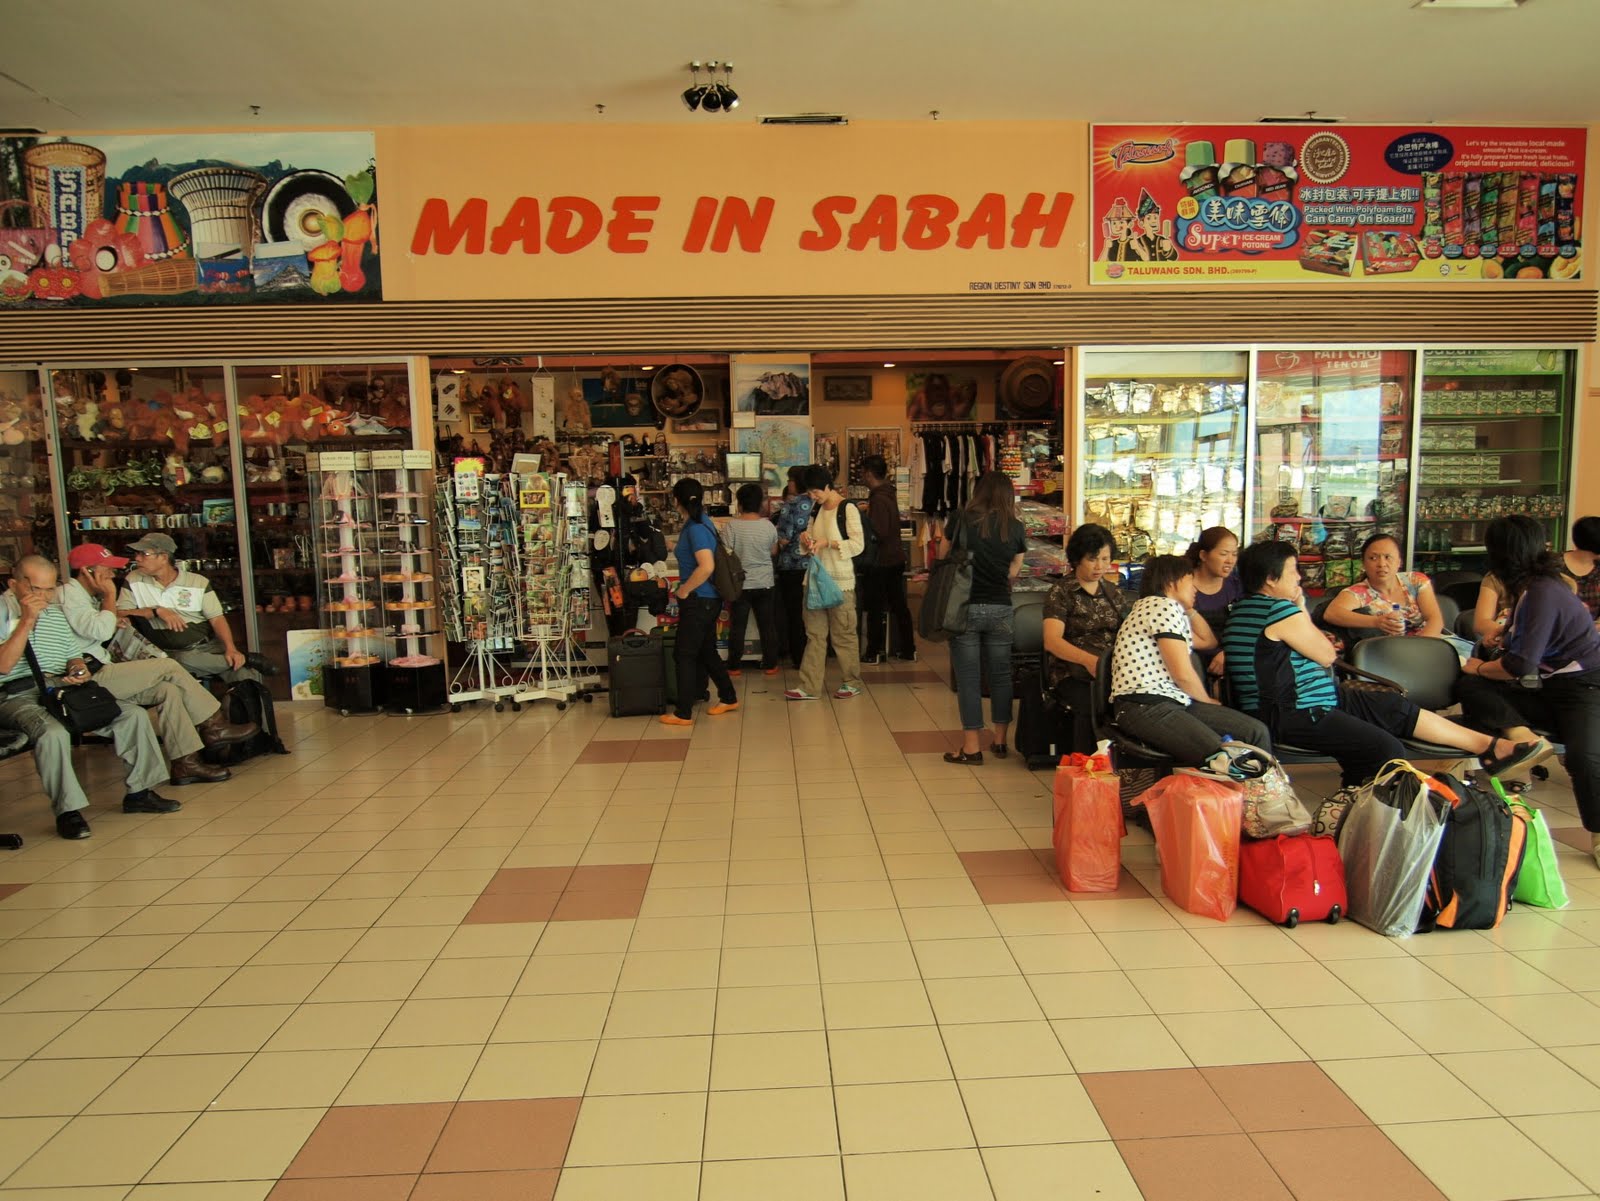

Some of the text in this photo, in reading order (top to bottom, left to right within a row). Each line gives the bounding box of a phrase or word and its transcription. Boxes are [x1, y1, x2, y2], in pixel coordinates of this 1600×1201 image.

[1455, 160, 1480, 168] original
[1304, 205, 1334, 213] Packed
[1335, 205, 1354, 213] With
[1356, 205, 1394, 215] Polyfoam
[410, 192, 1075, 256] MADE IN SABAH
[1305, 214, 1413, 226] Can Carry On Board!!
[1187, 223, 1281, 251] Super ICE-CREAM
[1127, 266, 1181, 276] TALUWANG
[1183, 266, 1206, 275] SDN.
[1208, 266, 1230, 275] BHD.
[994, 281, 1021, 290] DESTINY
[1023, 281, 1037, 290] SDN
[1326, 360, 1369, 369] TENOM
